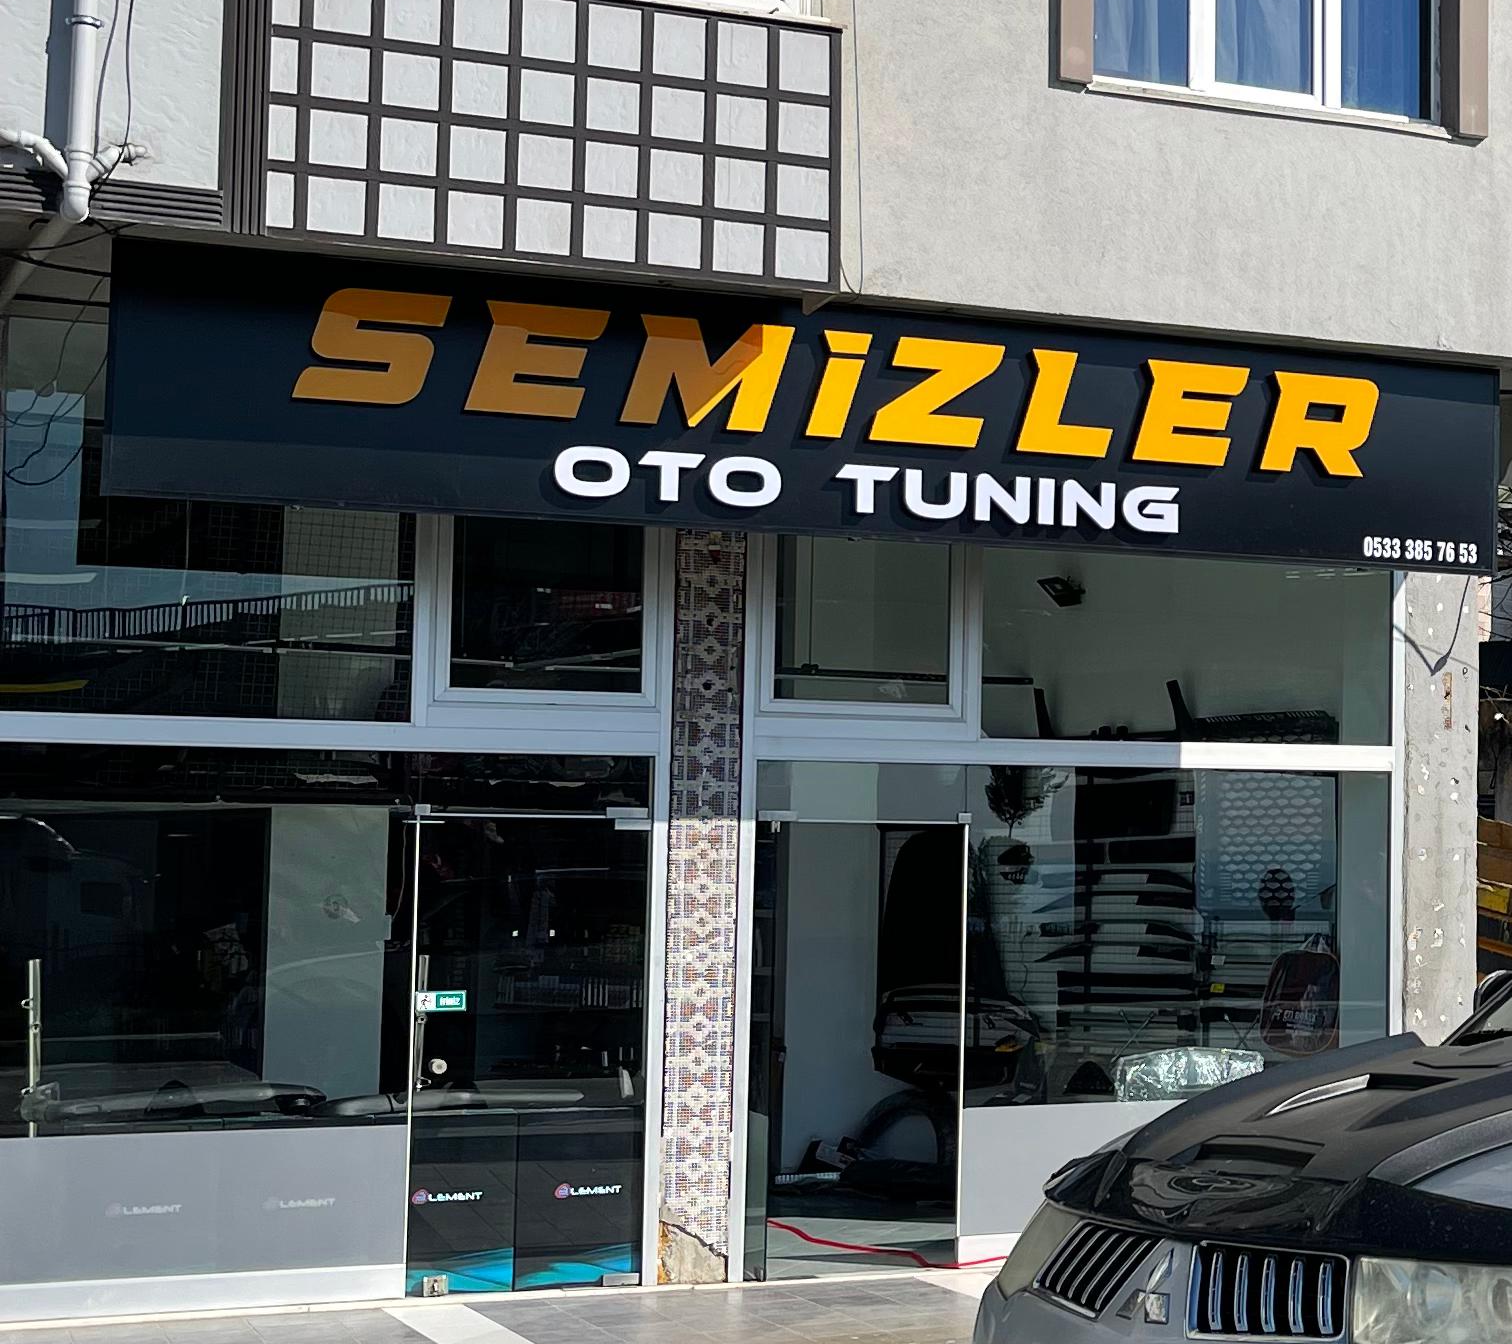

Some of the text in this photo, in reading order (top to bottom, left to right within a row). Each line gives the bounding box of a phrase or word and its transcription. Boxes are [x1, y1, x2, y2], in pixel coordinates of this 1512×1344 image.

[554, 445, 1181, 534] OTO TUNING
[1363, 535, 1478, 564] 0533 385 76 53
